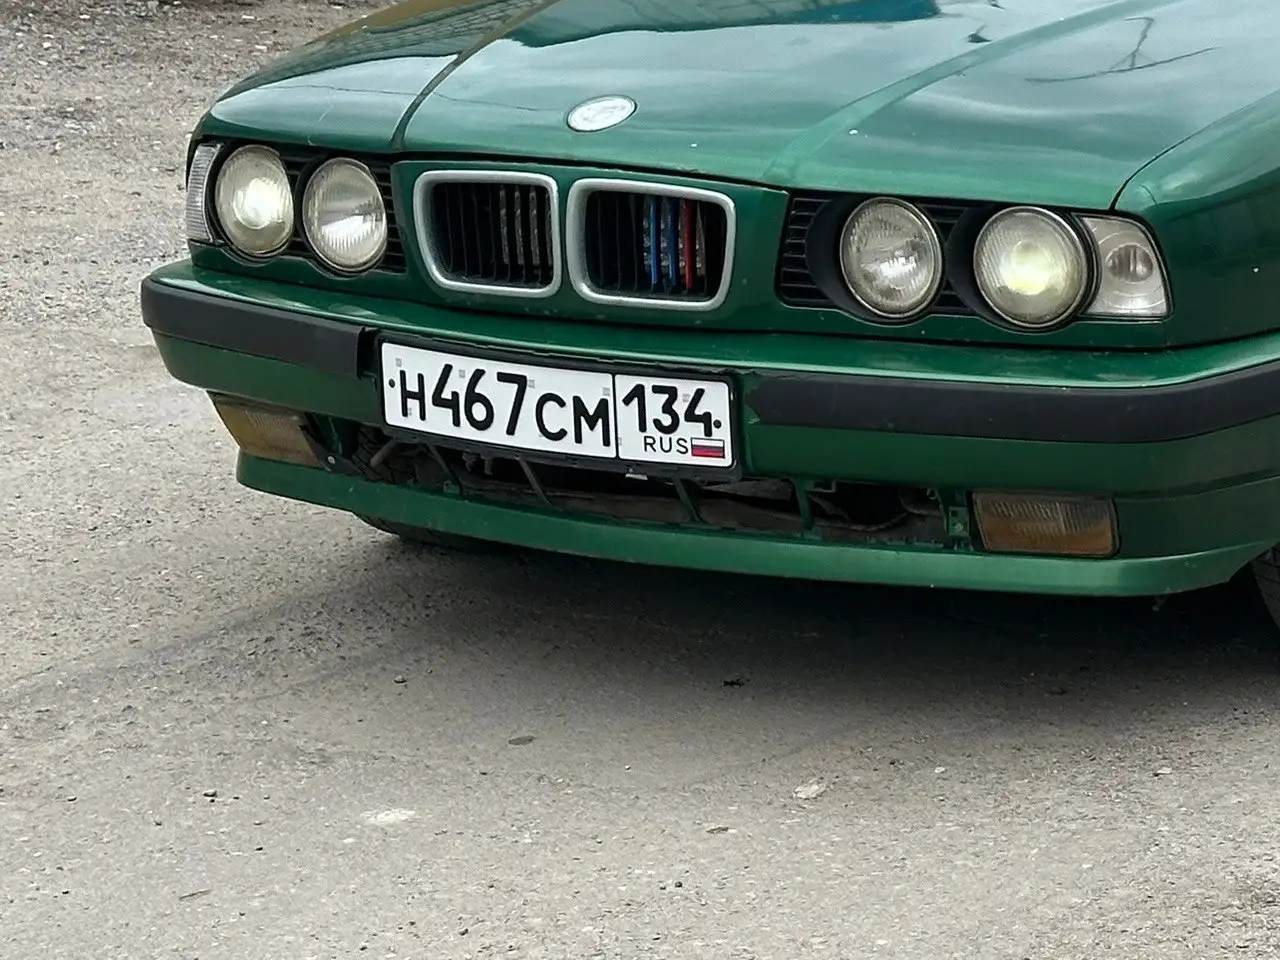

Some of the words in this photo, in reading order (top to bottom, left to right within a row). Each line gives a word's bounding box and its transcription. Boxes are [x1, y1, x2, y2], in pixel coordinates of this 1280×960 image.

[399, 363, 612, 447] Н467СМ
[622, 382, 714, 438] 134
[643, 435, 689, 455] RUS
